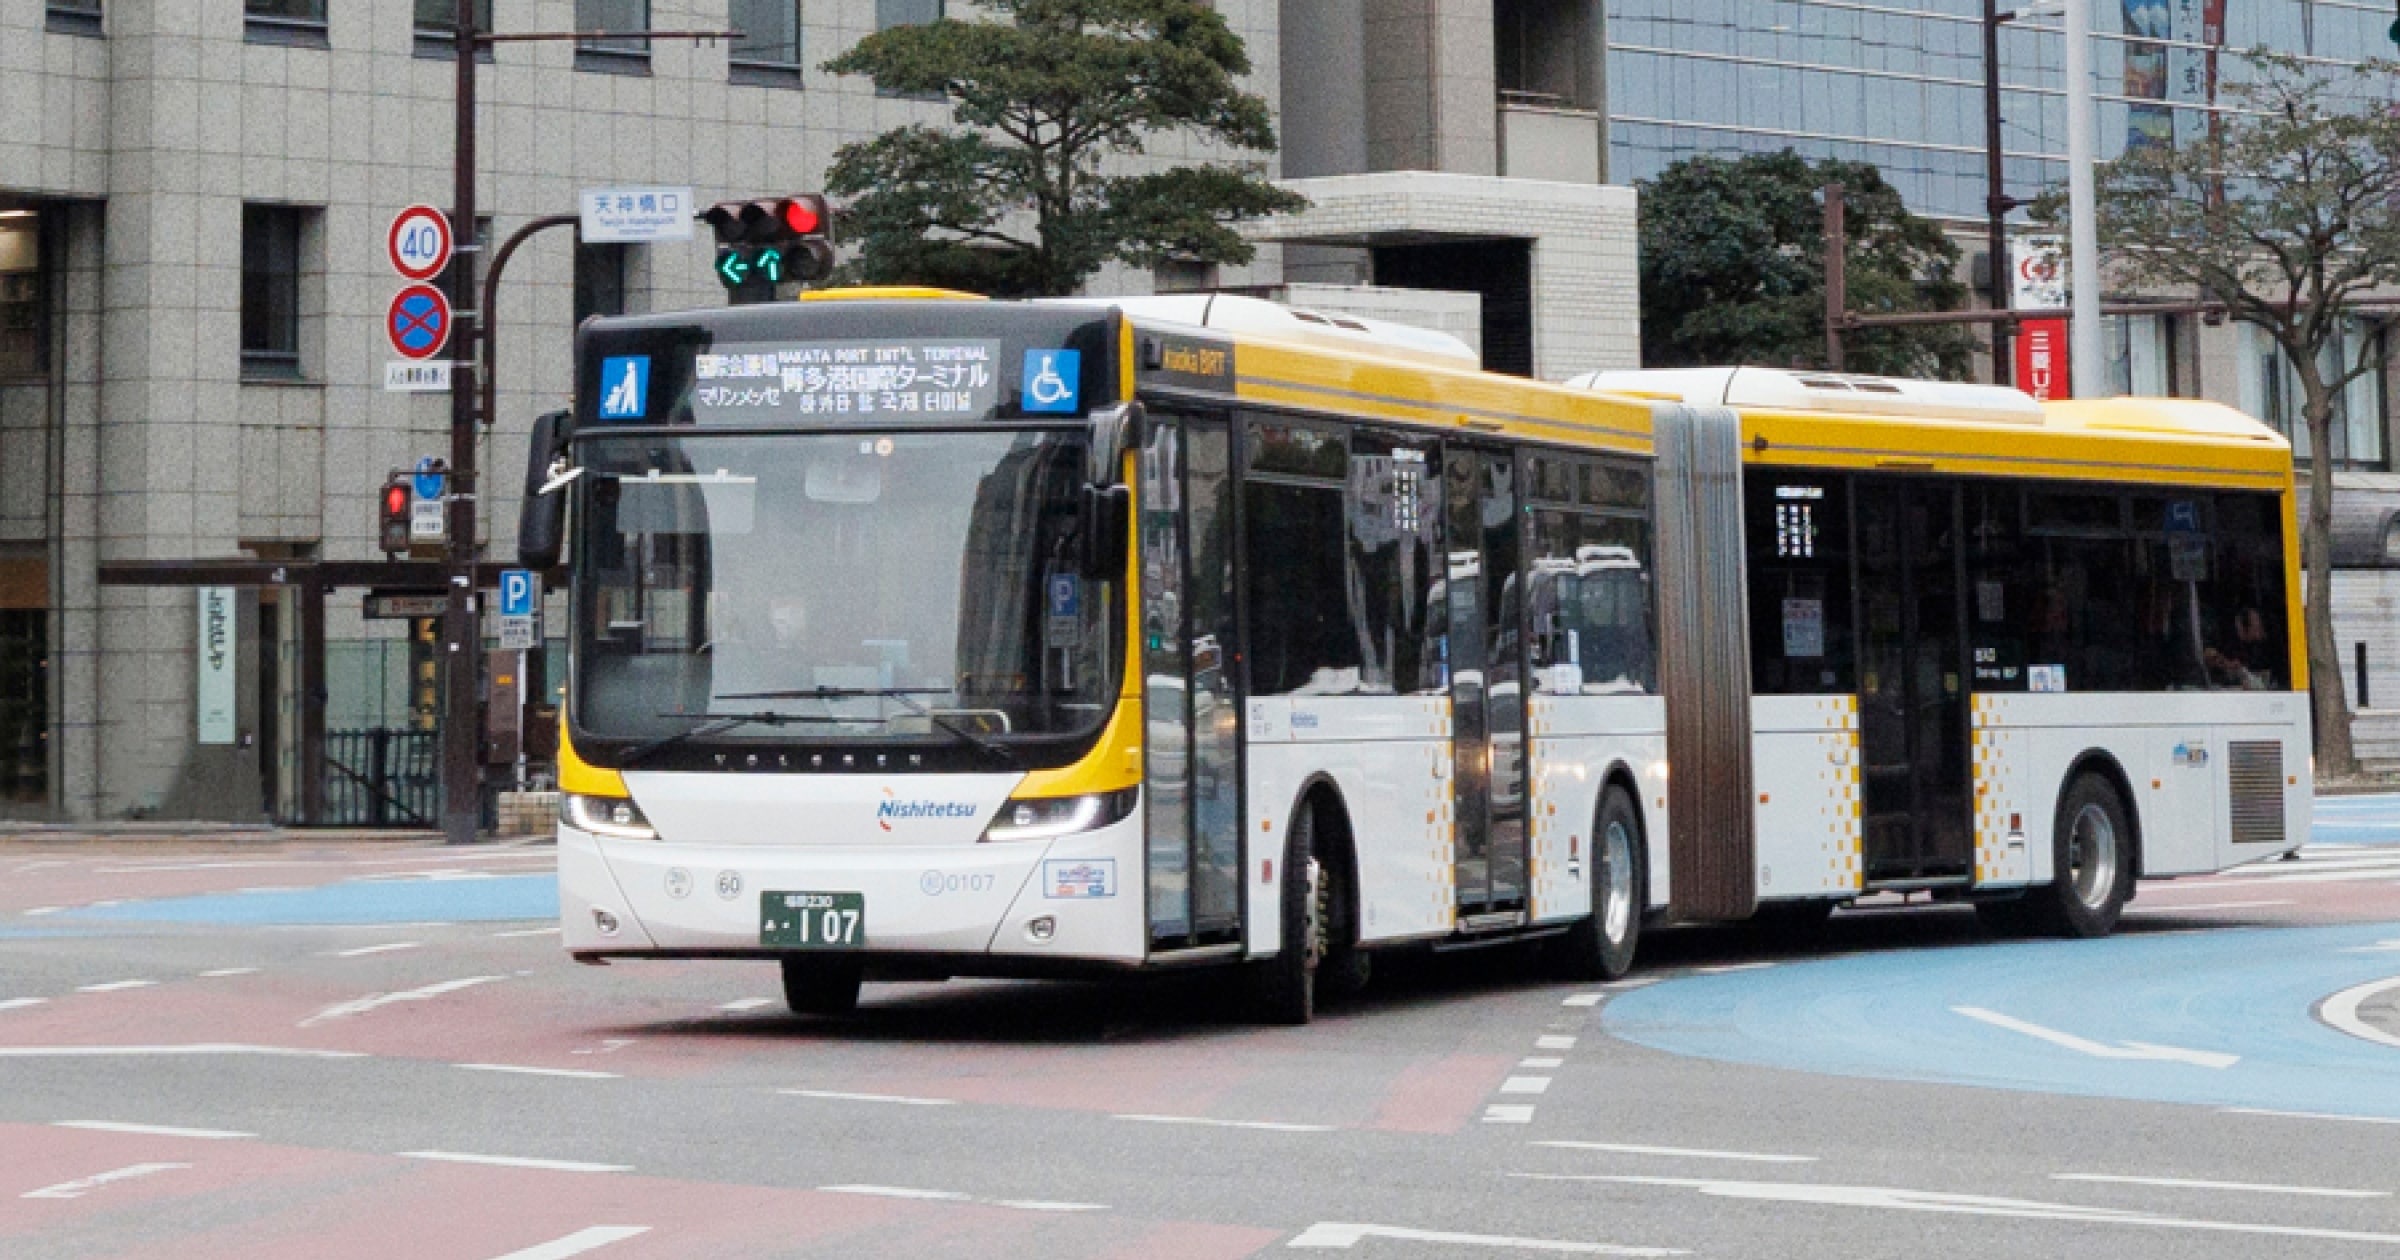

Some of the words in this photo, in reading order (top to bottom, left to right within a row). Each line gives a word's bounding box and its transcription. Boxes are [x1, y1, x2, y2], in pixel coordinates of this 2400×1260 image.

[594, 194, 678, 214] 天神橋口
[403, 226, 436, 259] 40
[699, 386, 780, 406] マリンメッセ
[508, 575, 527, 612] P
[877, 800, 976, 818] Nishitetsu
[720, 876, 740, 894] 60
[947, 873, 995, 892] 0107
